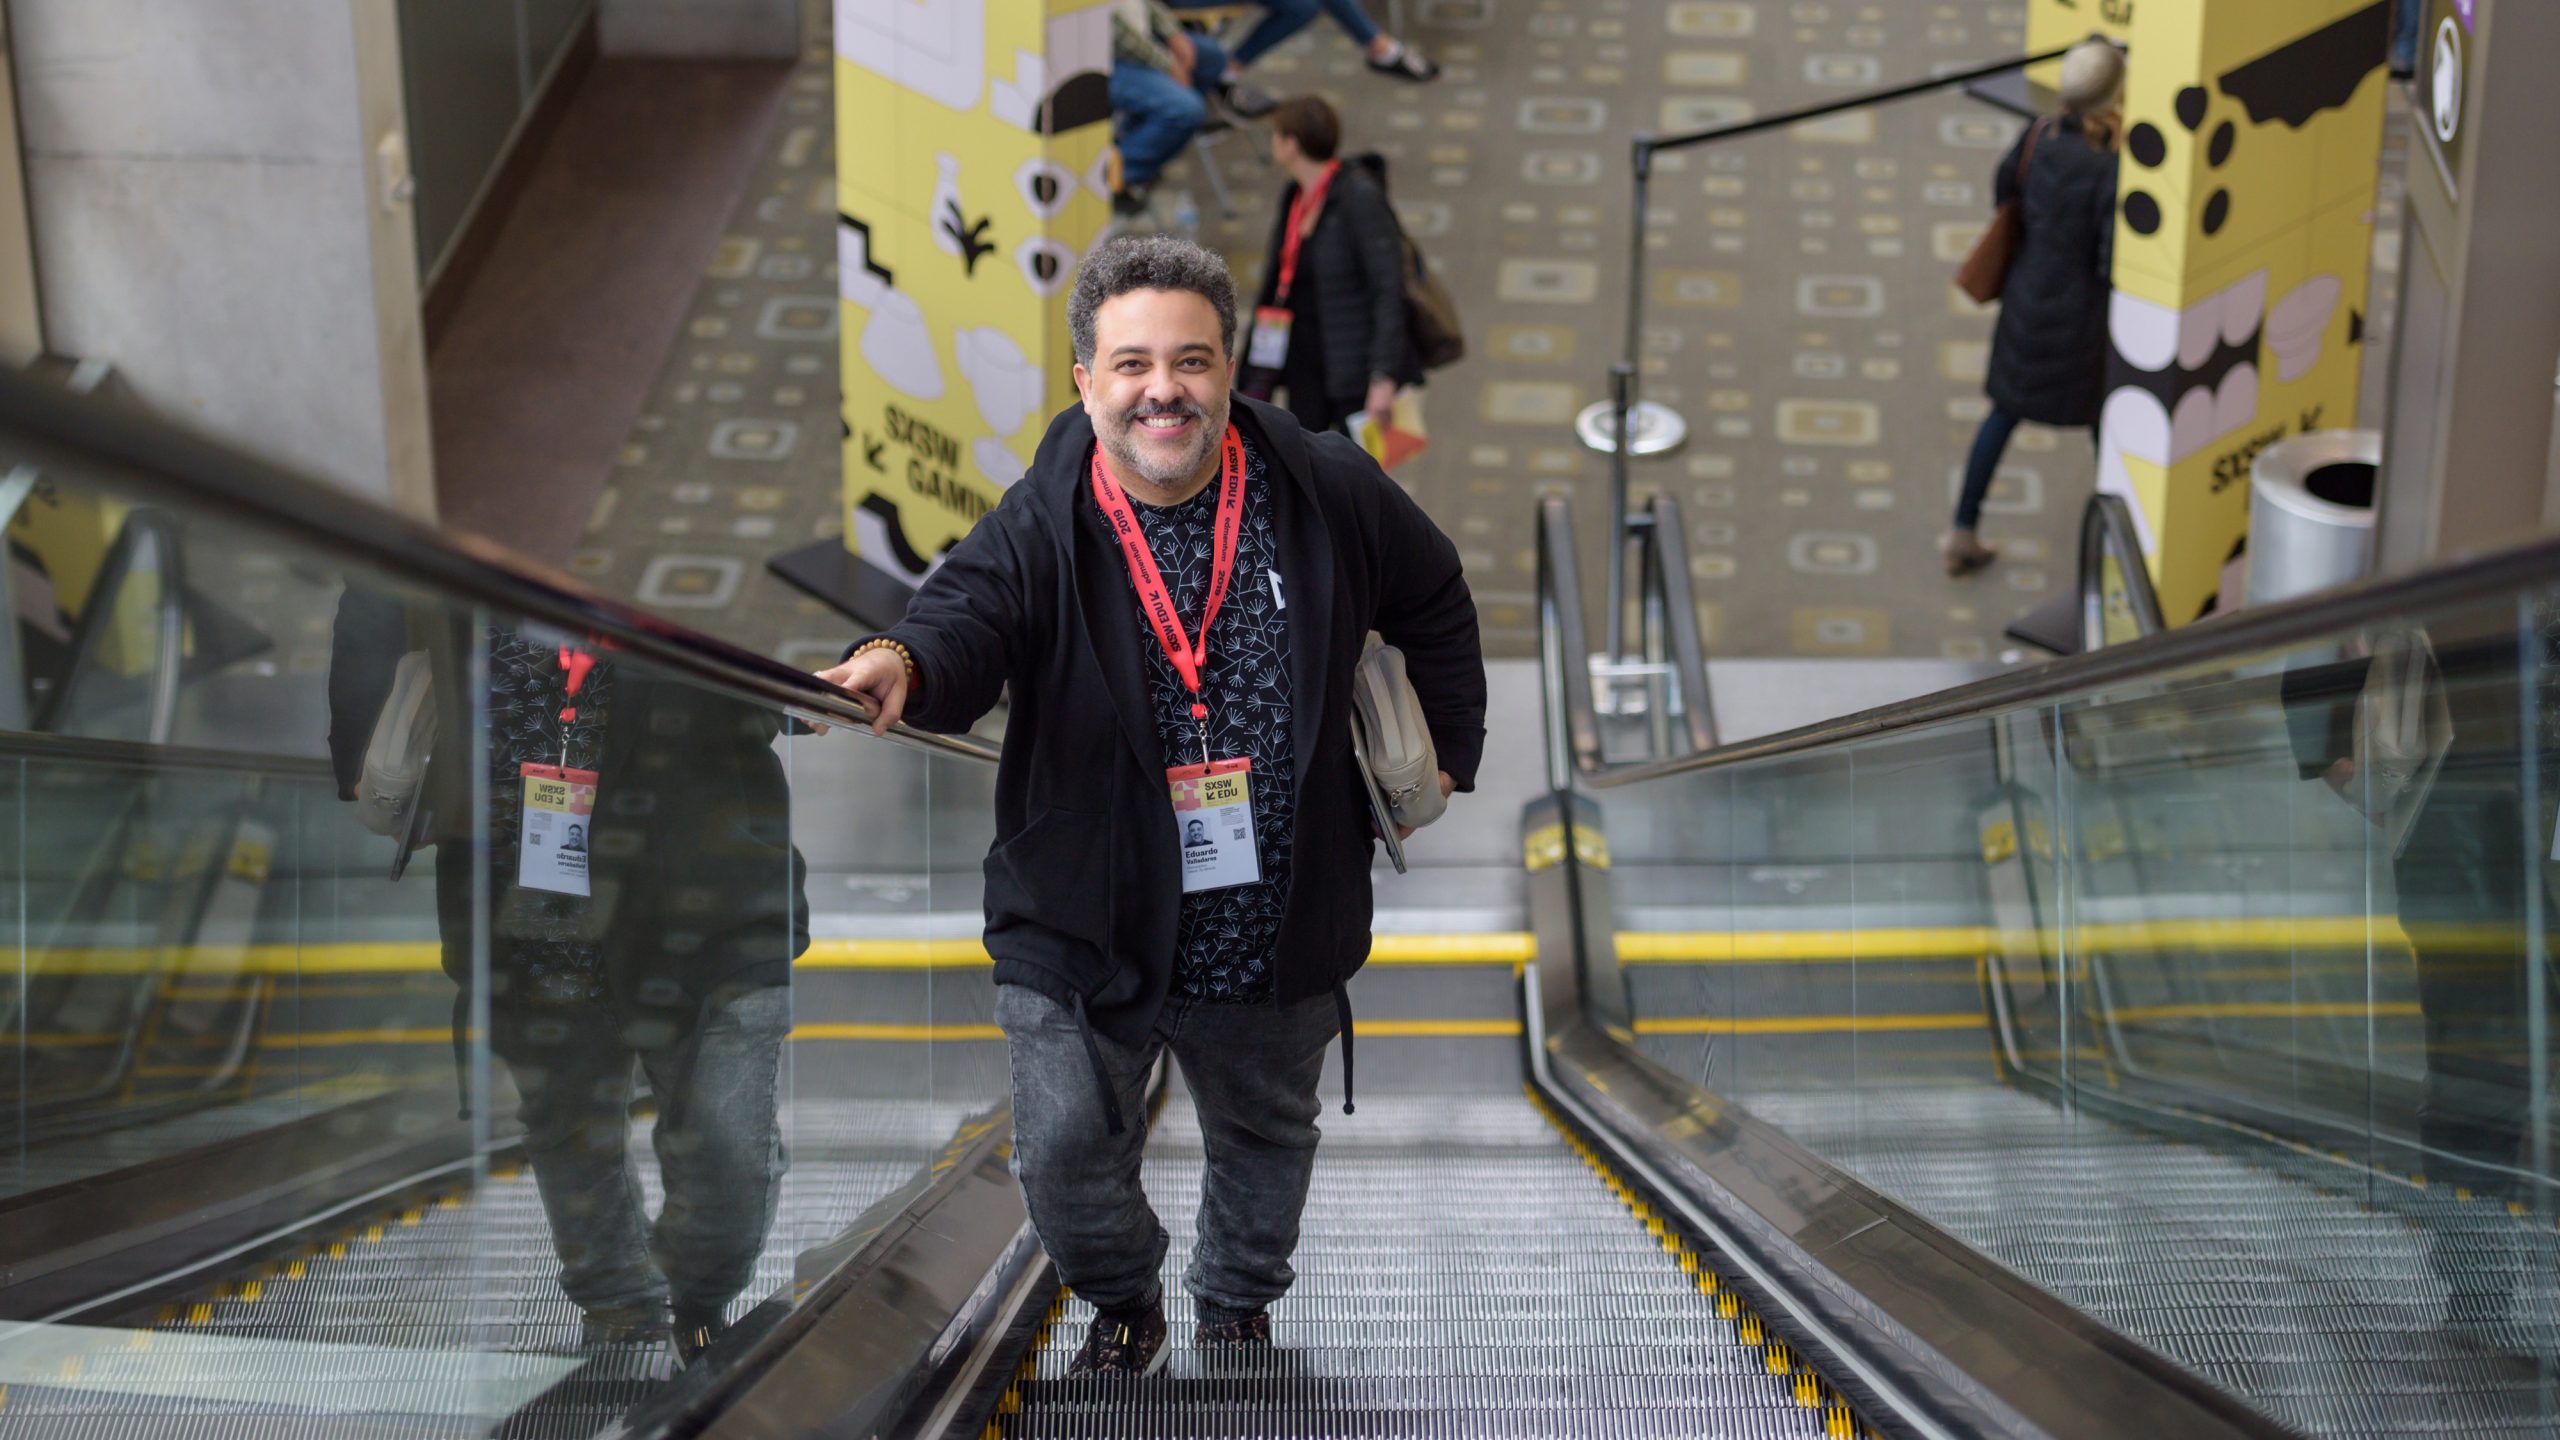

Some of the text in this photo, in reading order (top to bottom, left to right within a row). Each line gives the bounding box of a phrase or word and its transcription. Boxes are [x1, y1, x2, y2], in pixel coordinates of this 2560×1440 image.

[885, 404, 960, 469] SXSW
[1228, 446, 1239, 473] SXSW
[907, 457, 995, 521] GAMIN
[1095, 461, 1115, 501] edmentum
[1228, 475, 1239, 497] EDU
[1113, 509, 1132, 535] 2019
[1221, 517, 1231, 562] edmentum
[1129, 541, 1152, 585] edmentum
[1153, 600, 1182, 653] SXSW EDU
[1204, 779, 1232, 791] SXSW
[1217, 787, 1238, 799] EDU
[1185, 848, 1218, 858] Eduardo
